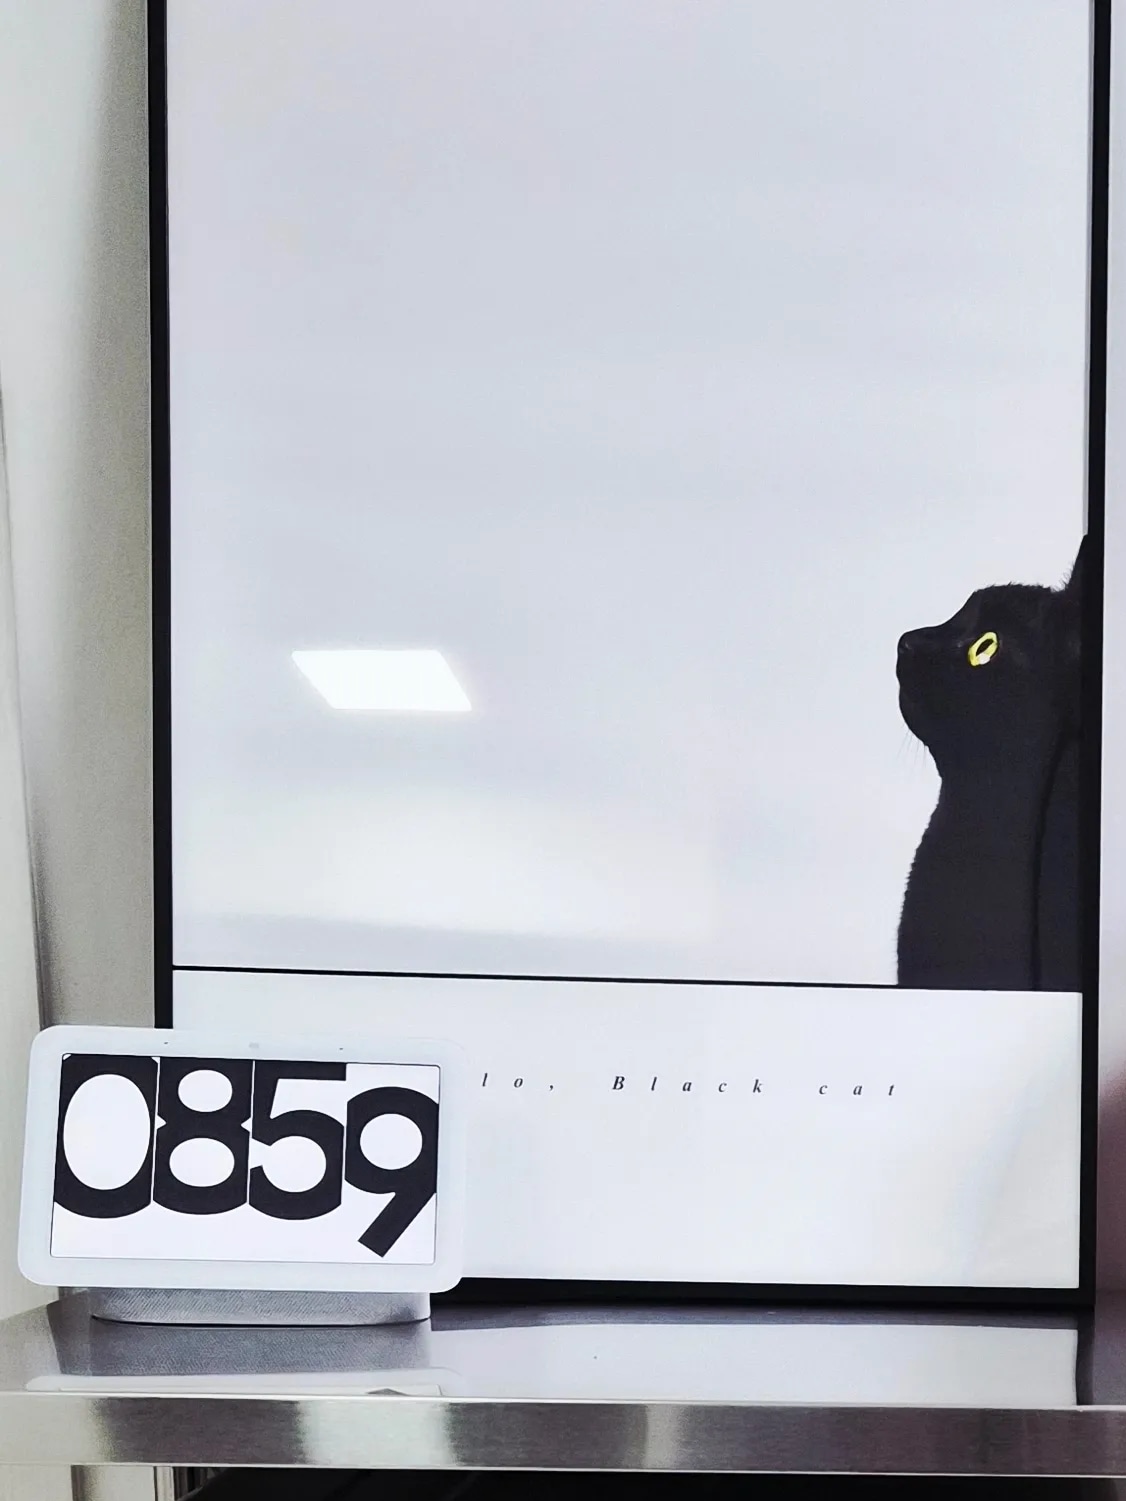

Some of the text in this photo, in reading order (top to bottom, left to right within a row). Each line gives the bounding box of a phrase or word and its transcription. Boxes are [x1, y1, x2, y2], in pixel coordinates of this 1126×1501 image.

[612, 1074, 765, 1094] Black
[818, 1082, 896, 1098] cat
[52, 1053, 440, 1258] 0859
